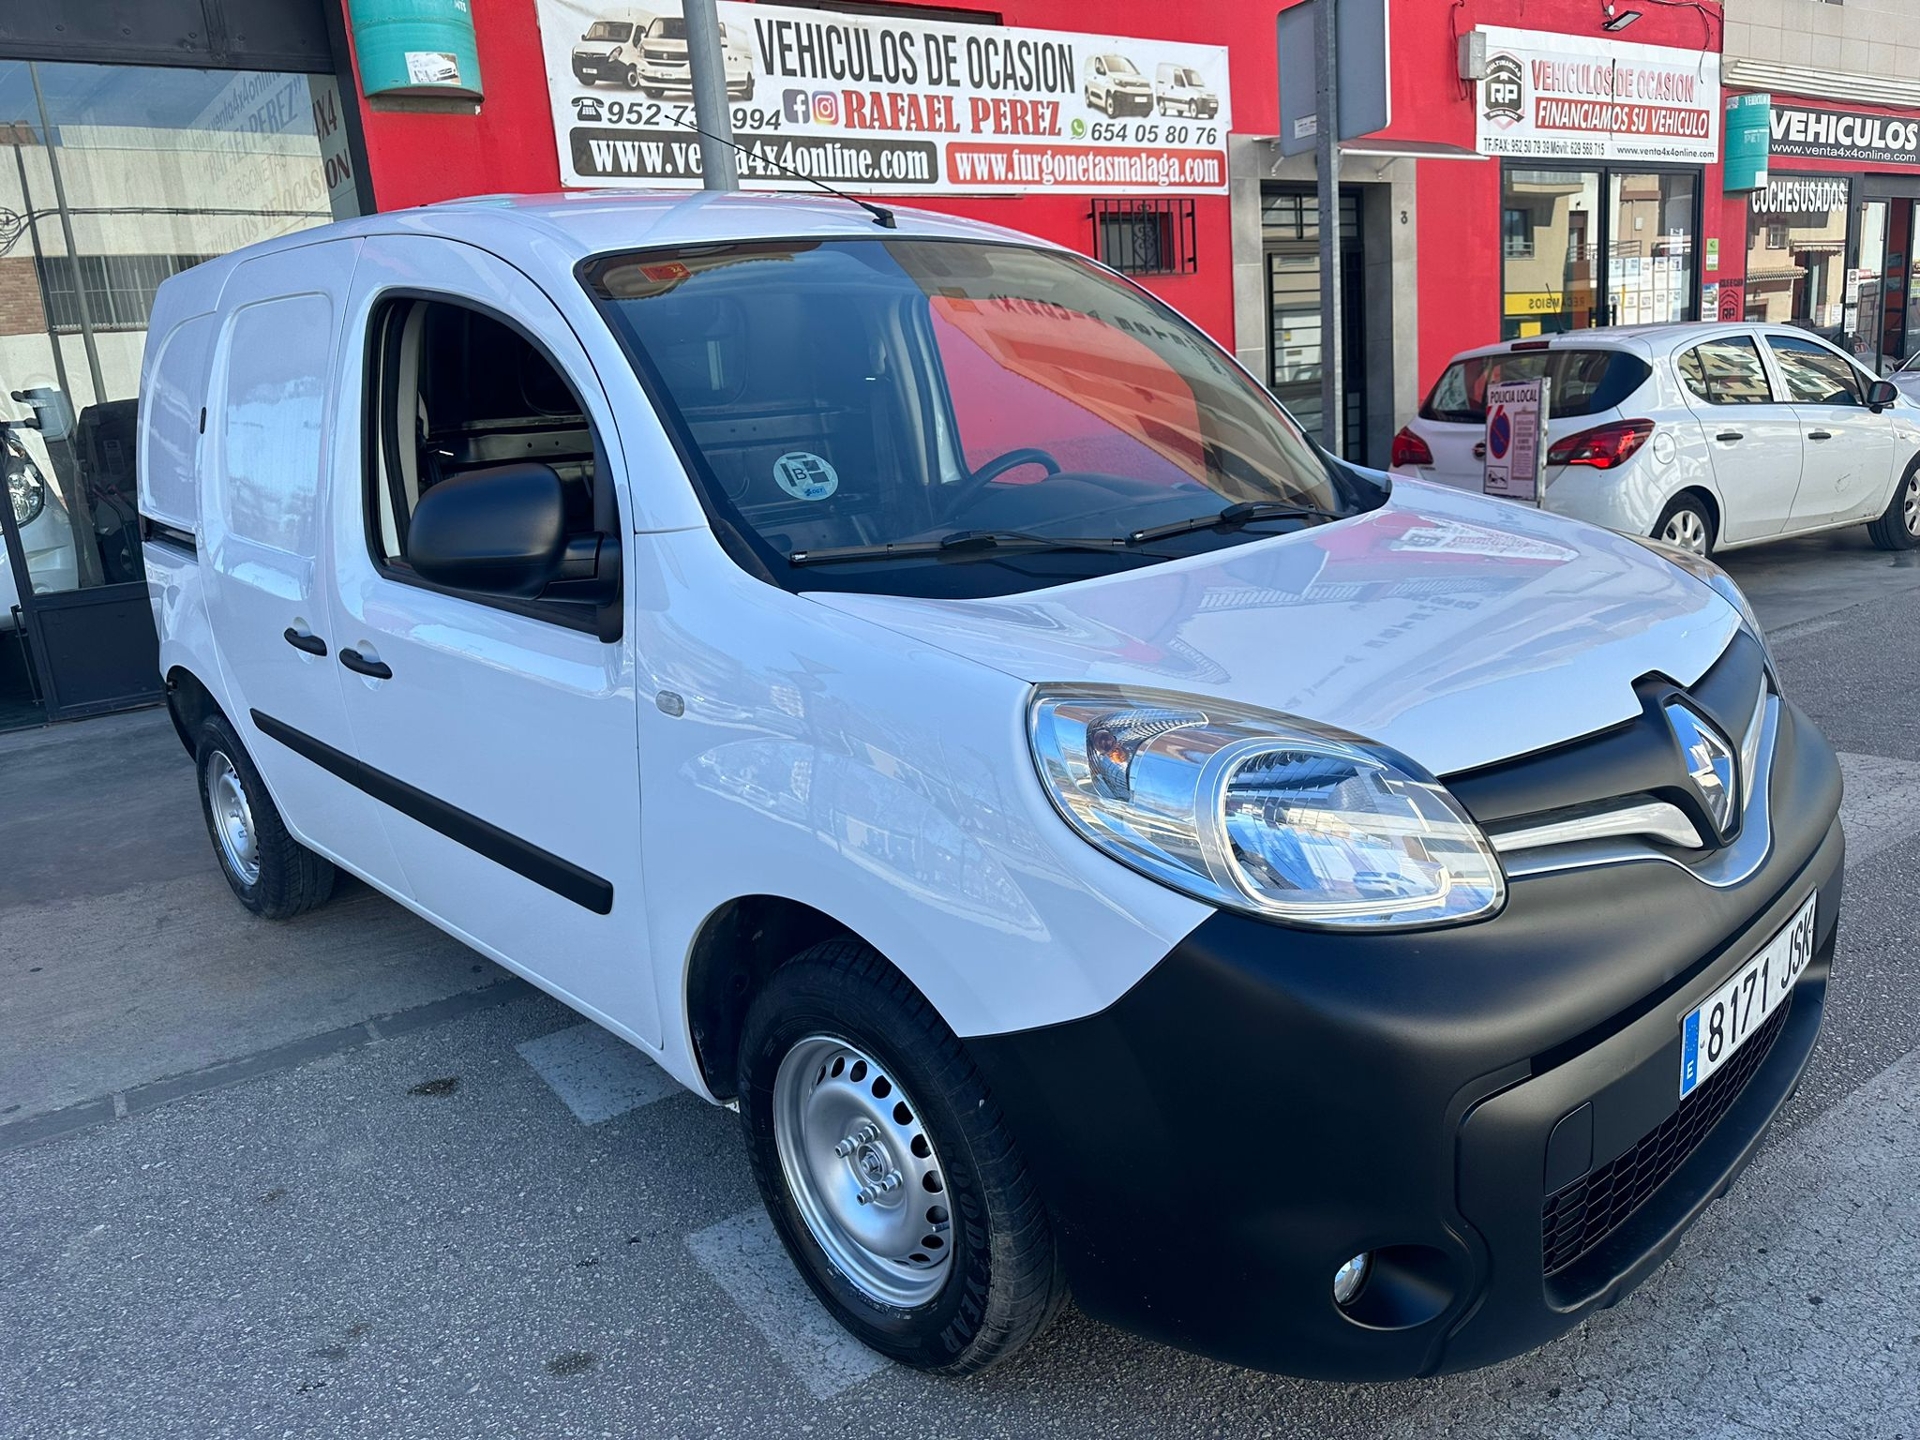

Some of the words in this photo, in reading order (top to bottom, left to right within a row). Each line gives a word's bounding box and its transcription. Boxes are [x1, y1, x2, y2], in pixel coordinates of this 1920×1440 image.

[754, 18, 918, 84] VEHICULOS
[923, 33, 960, 87] DE
[966, 36, 1076, 94] OCASION
[1490, 83, 1518, 103] RP
[1532, 59, 1612, 97] VEHICULOS
[1615, 67, 1634, 98] DE
[1636, 69, 1695, 103] OCASION
[607, 101, 661, 126] 952
[733, 107, 781, 131] 994
[842, 90, 960, 134] RAFAEL
[968, 97, 1062, 136] PEREZ
[1537, 102, 1628, 132] FINANCIAMOS
[1631, 107, 1648, 132] SU
[1651, 110, 1708, 136] VEHICULO
[1091, 122, 1128, 142] 654
[1135, 124, 1158, 143] 05
[1166, 125, 1188, 144] 80
[1195, 126, 1217, 145] 76
[1769, 109, 1918, 151] VEHICULOS
[589, 138, 929, 182] www.vea4x4online.com
[955, 150, 1219, 186] www.furgonetasmalaga.com
[1616, 146, 1715, 159] www.venta4x4online.com
[1771, 143, 1916, 163] www.venta4x4online.com
[1516, 388, 1538, 402] LOCAL
[792, 468, 807, 480] B
[1707, 957, 1770, 1063] 8171
[1780, 903, 1814, 990] JSK
[1686, 1060, 1694, 1079] E
